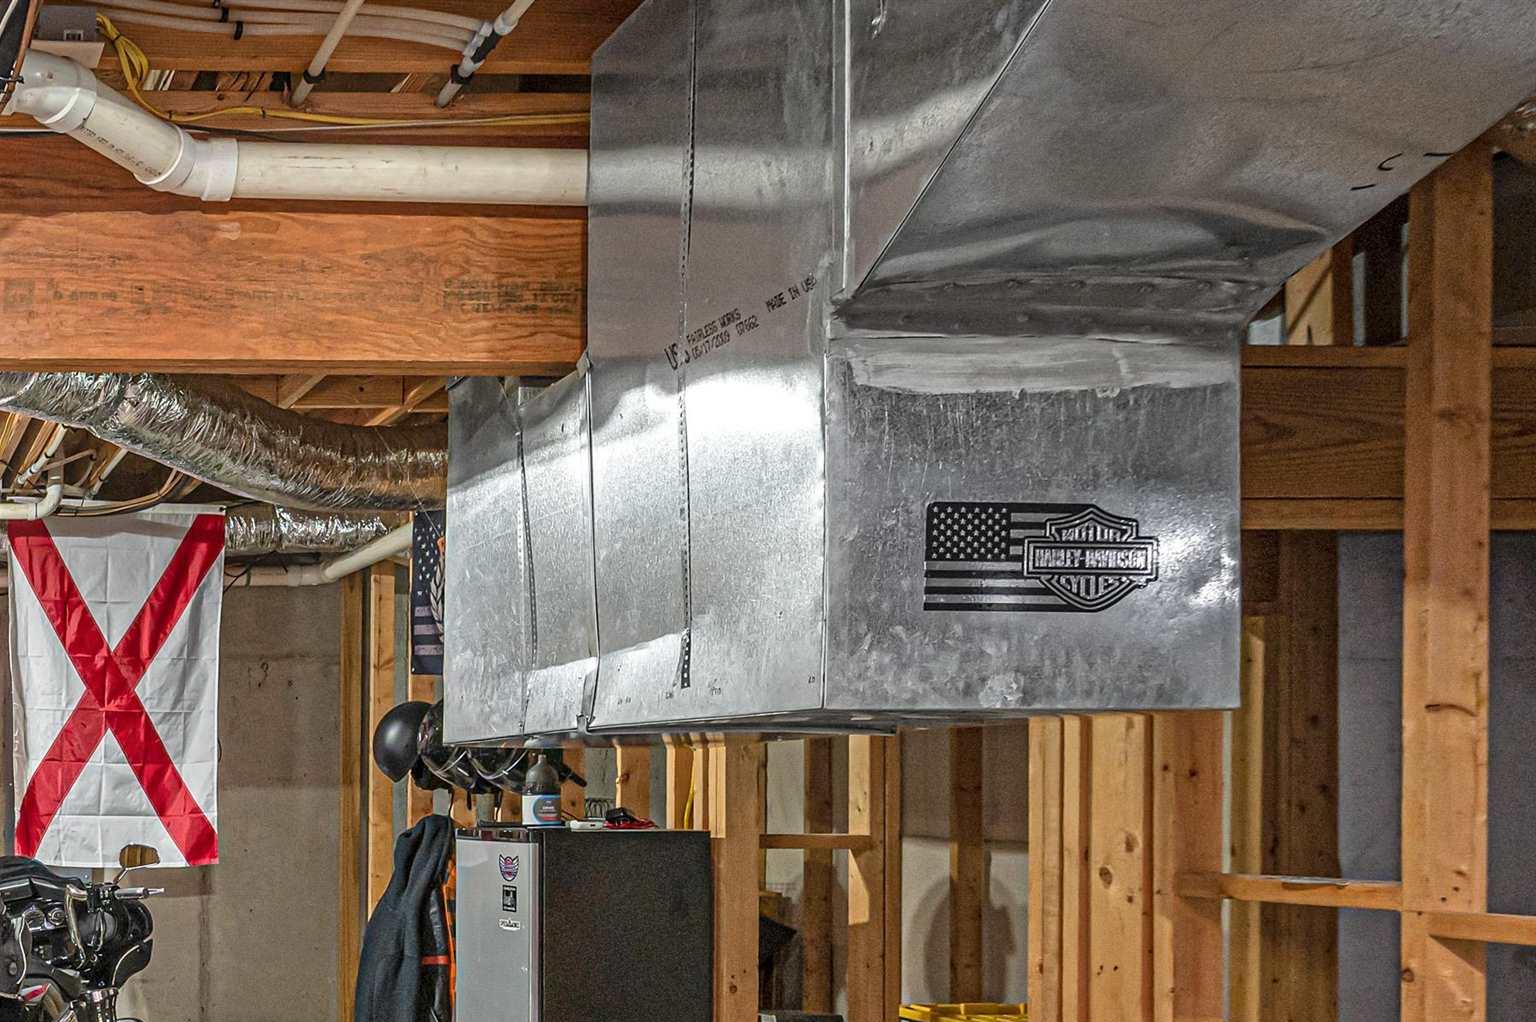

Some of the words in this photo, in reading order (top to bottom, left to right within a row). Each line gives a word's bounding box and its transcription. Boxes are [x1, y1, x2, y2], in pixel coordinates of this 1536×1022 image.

[765, 292, 787, 313] MADE
[788, 286, 800, 300] IN
[686, 321, 719, 345] FAIRLESS
[720, 307, 743, 328] WORKS
[1034, 547, 1147, 569] HARLEY-DAVIDSON
[1059, 575, 1120, 600] CYCLES
